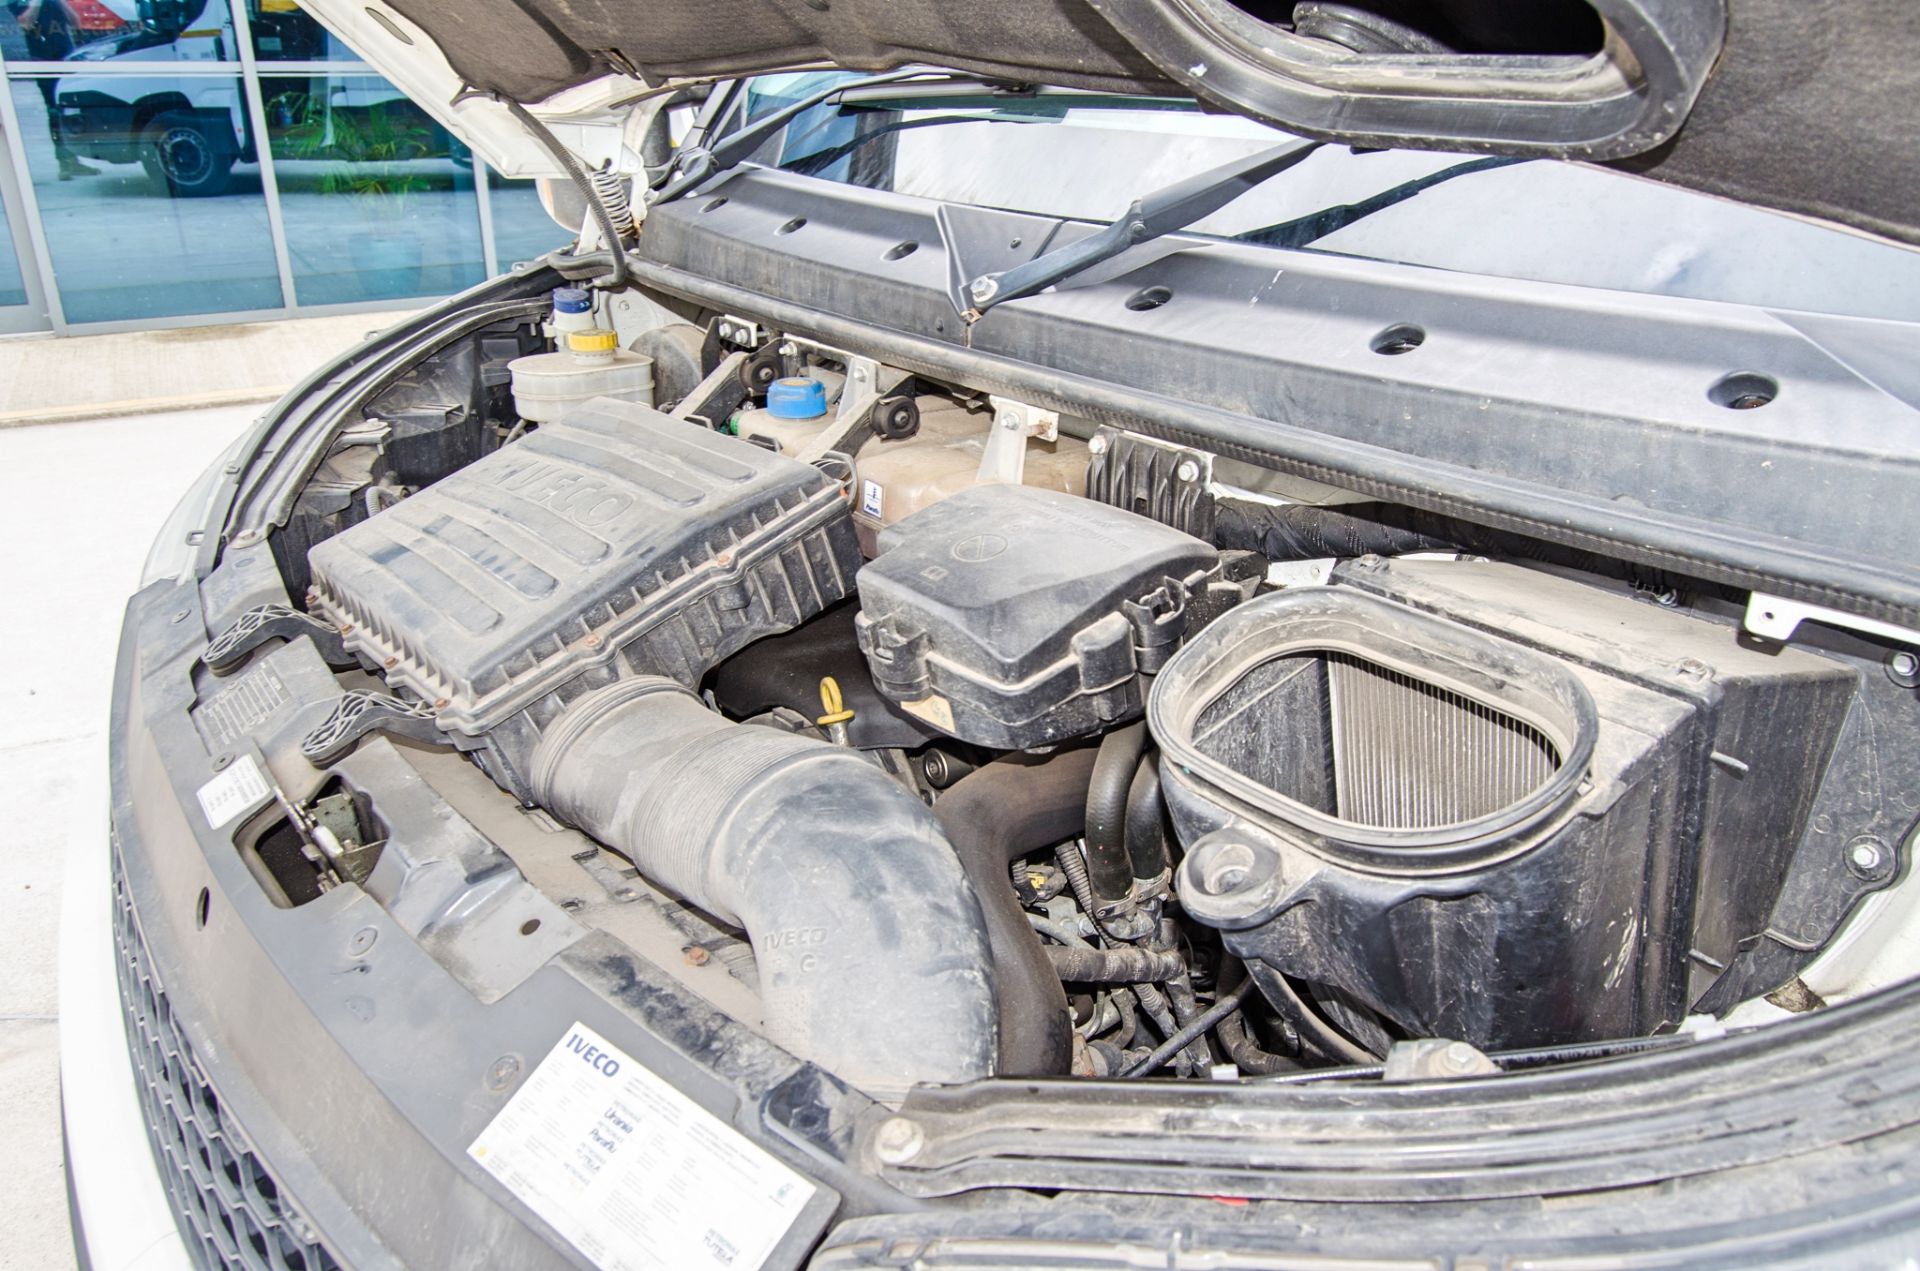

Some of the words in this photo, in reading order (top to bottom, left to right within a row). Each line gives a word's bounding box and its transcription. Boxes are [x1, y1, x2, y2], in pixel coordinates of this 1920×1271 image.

[490, 458, 636, 527] IVECO
[763, 927, 828, 953] IVECO
[565, 1034, 620, 1079] IVECO
[603, 1107, 633, 1134] Urania
[589, 1128, 617, 1154] Paraflu
